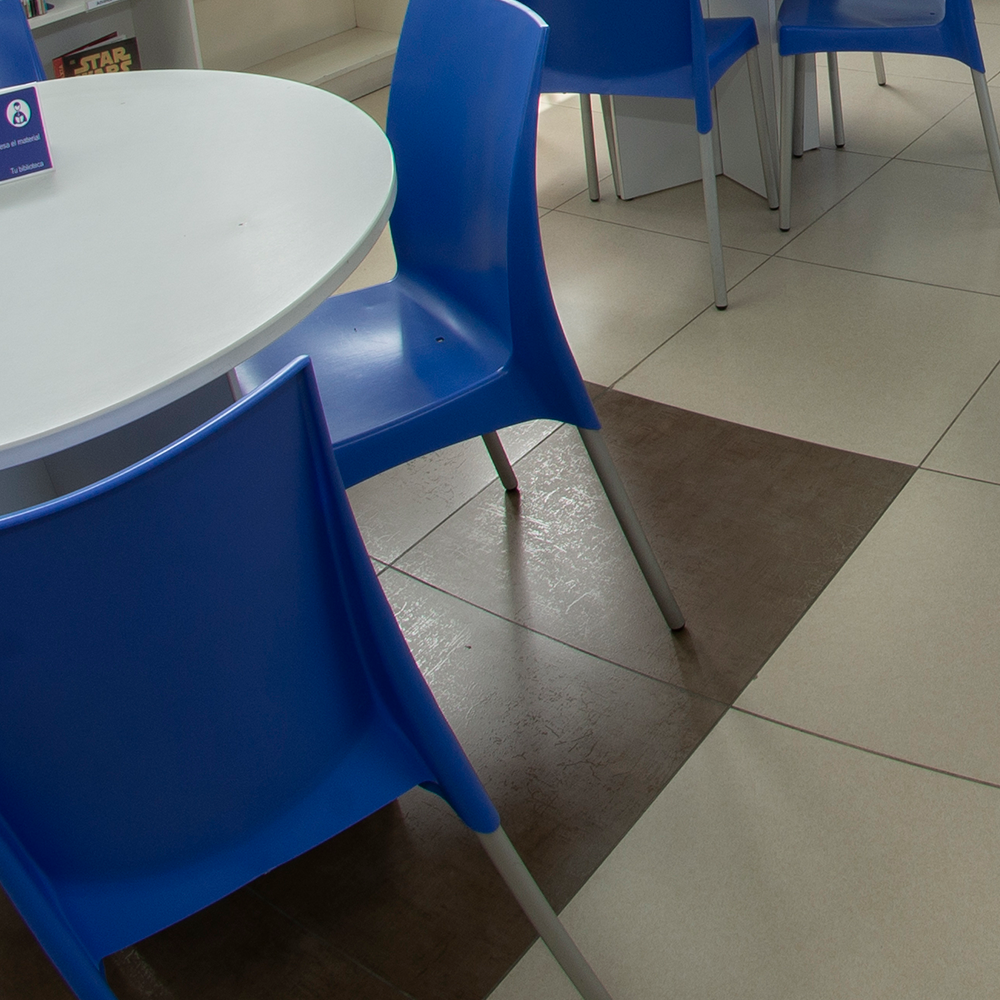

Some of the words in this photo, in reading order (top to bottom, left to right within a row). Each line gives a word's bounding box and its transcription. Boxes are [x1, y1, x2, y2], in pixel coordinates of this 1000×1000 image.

[79, 47, 132, 71] STAR
[10, 139, 17, 148] el
[17, 133, 41, 146] material
[10, 167, 19, 175] Tu
[18, 161, 45, 173] biblioteca
